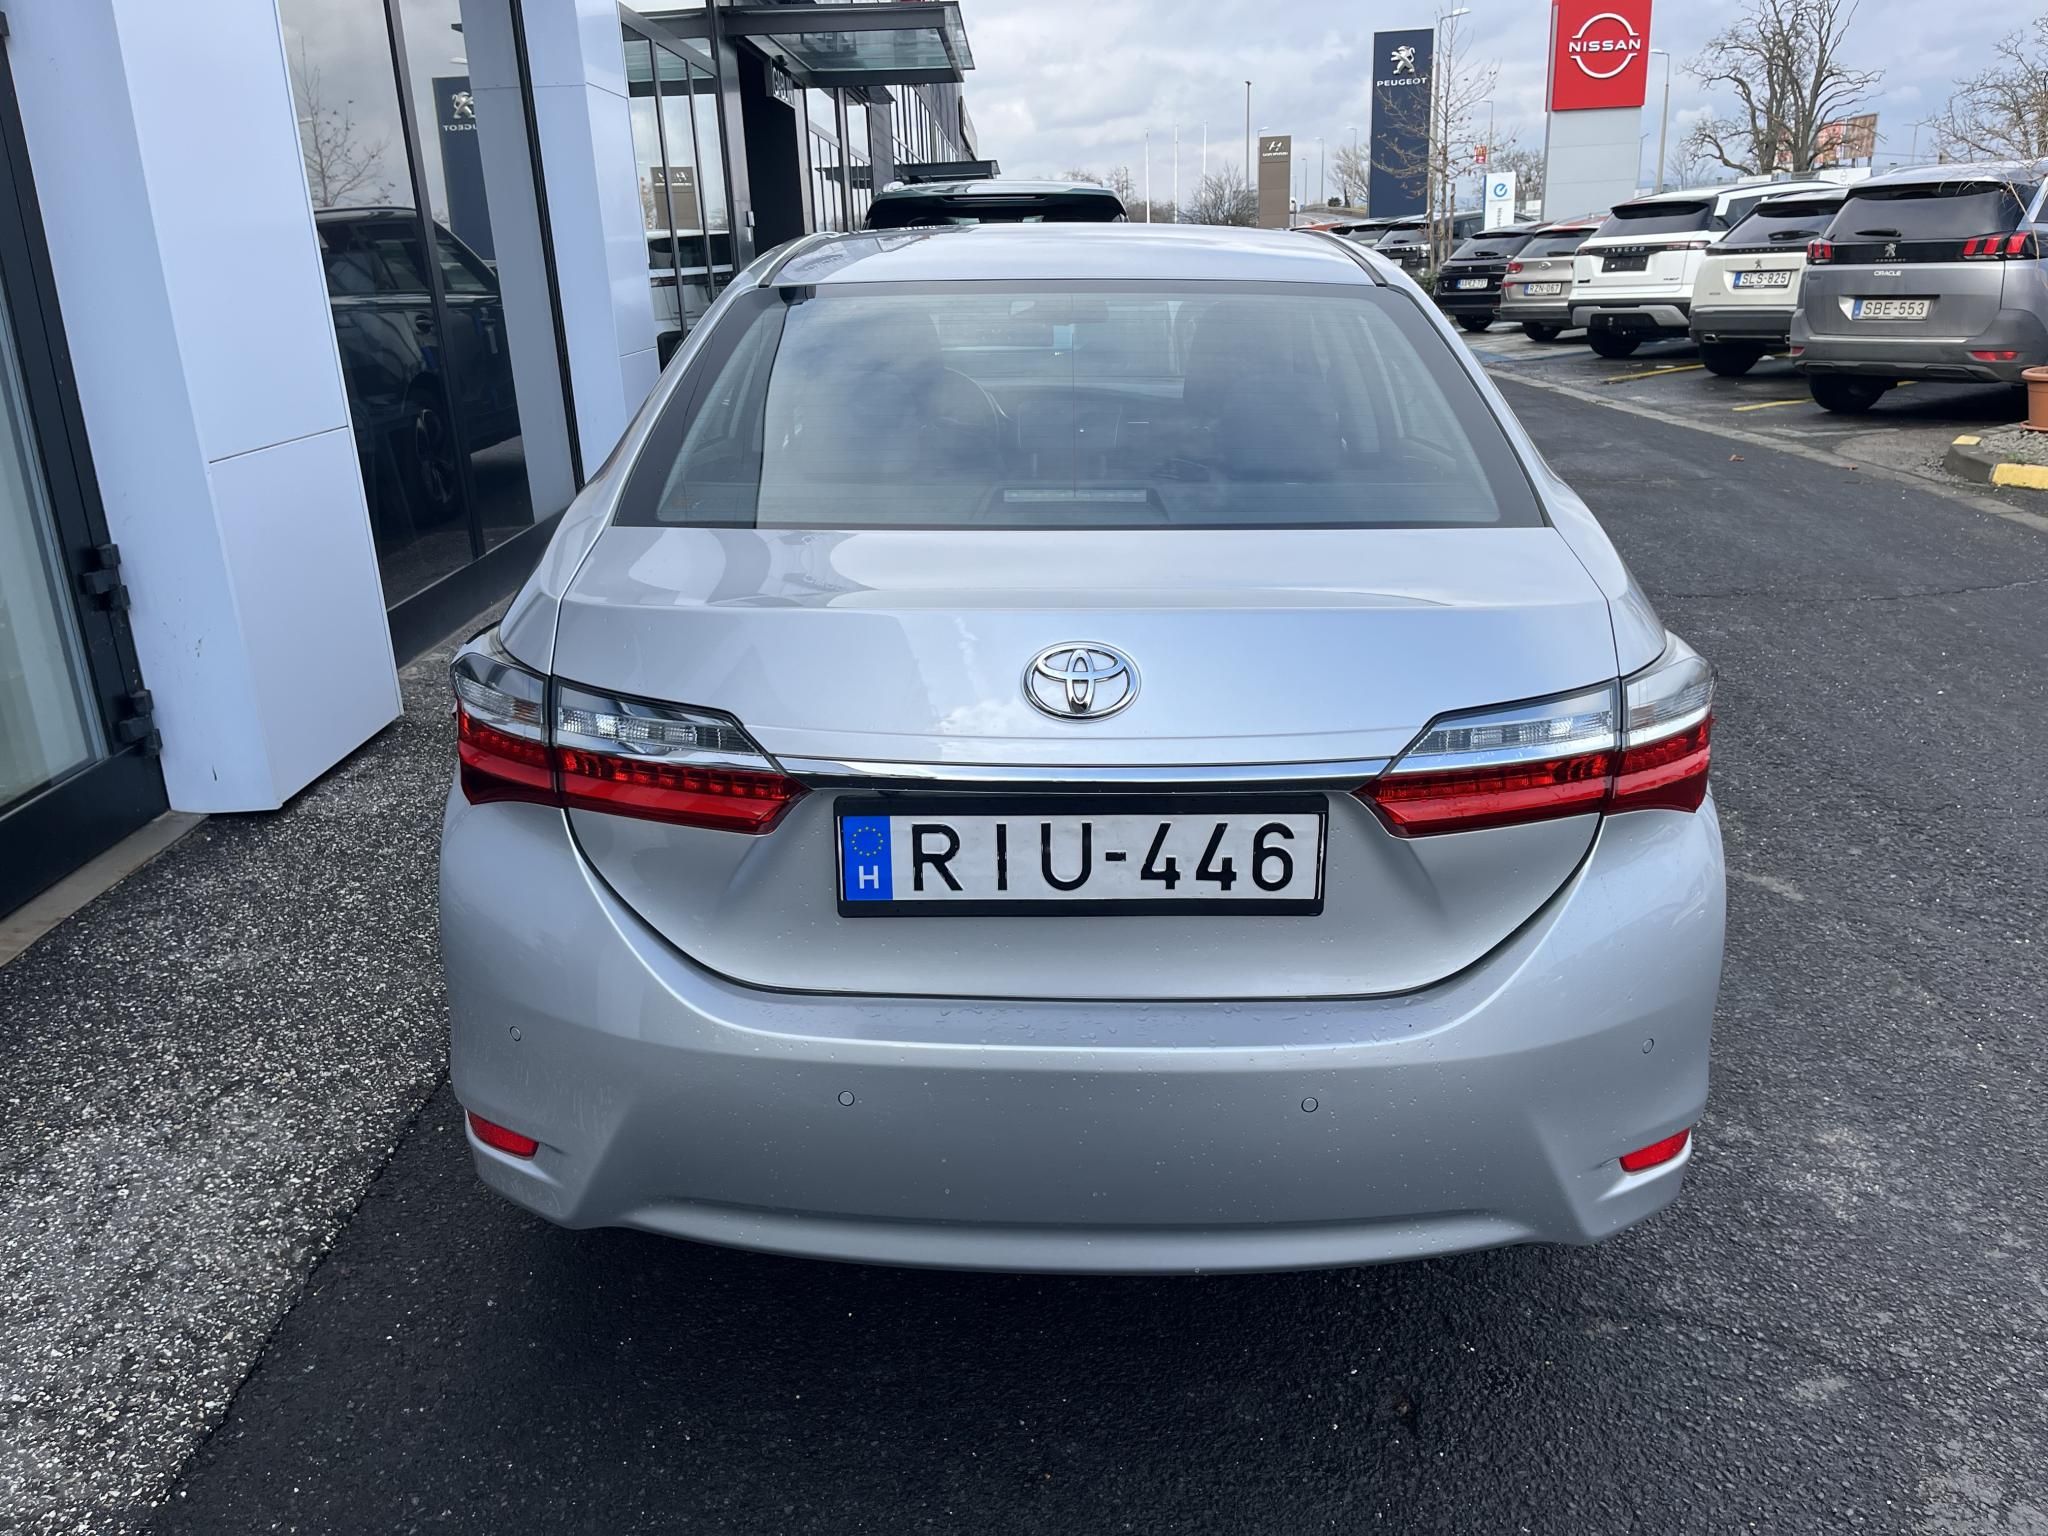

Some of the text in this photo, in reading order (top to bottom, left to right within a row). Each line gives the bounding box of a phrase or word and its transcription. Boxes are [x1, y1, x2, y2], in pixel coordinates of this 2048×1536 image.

[1568, 39, 1641, 53] NISSAN
[1376, 77, 1427, 87] PEUGEOT
[1742, 272, 1787, 285] SLS-825
[1863, 302, 1925, 316] SBE-553
[858, 822, 1295, 892] H RIU-446
